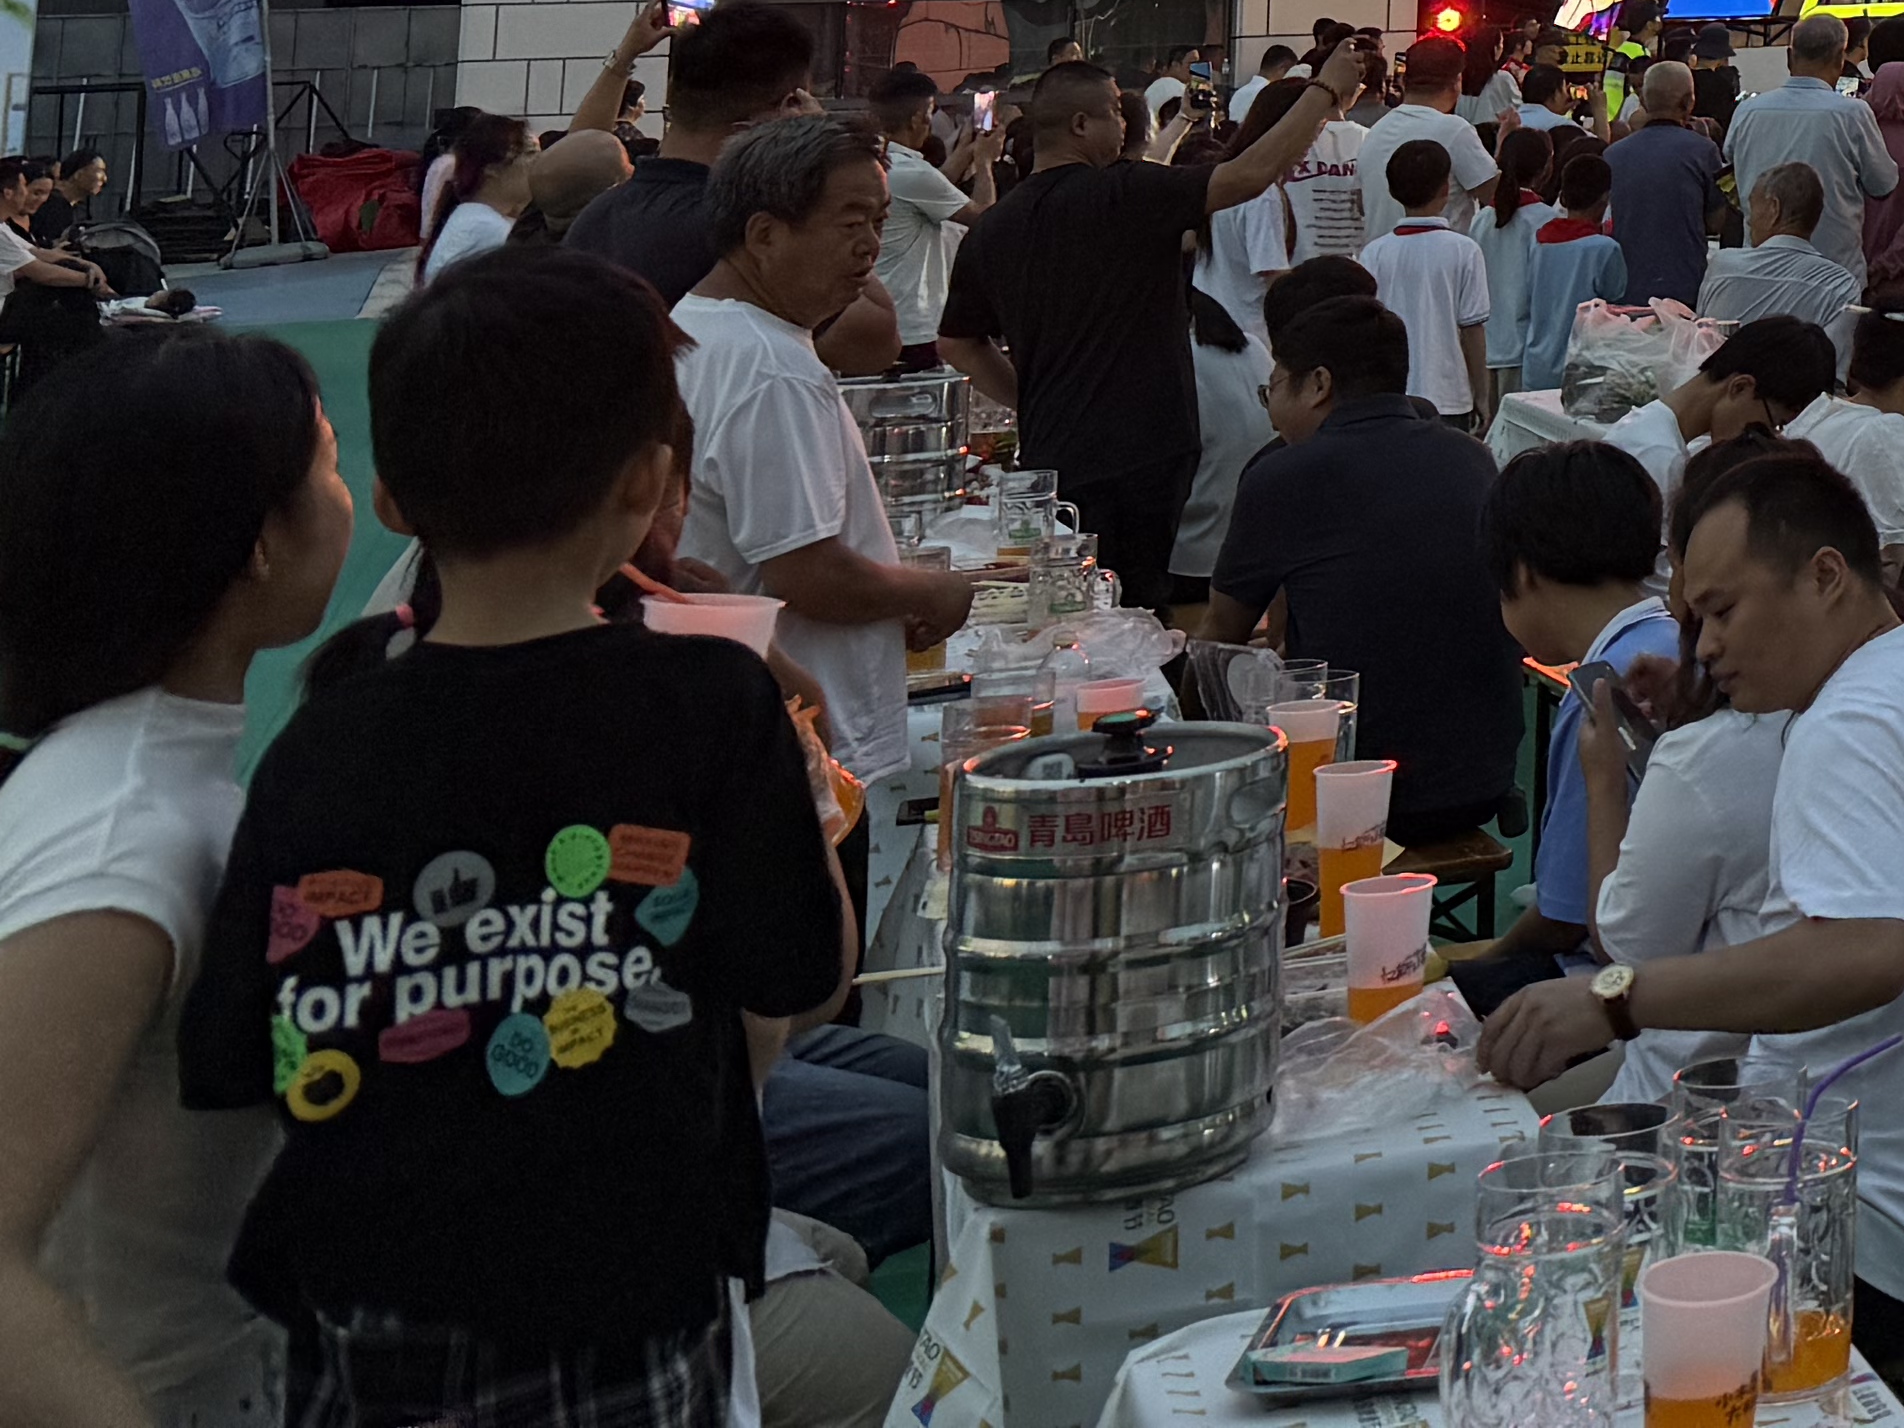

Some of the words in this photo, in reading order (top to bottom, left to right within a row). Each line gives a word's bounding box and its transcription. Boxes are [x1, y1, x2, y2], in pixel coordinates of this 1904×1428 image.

[1027, 803, 1173, 848] 青島啤酒
[334, 910, 443, 978] We
[465, 886, 615, 954] exist
[277, 974, 373, 1034] for
